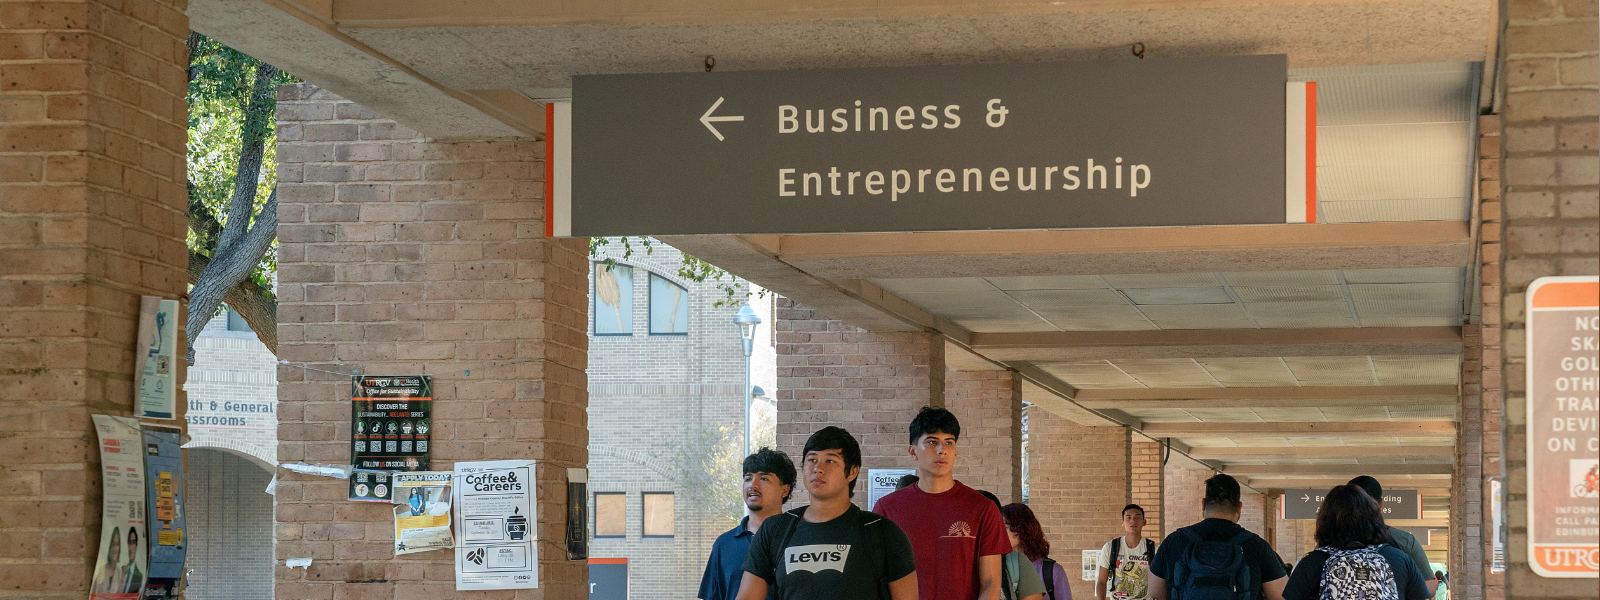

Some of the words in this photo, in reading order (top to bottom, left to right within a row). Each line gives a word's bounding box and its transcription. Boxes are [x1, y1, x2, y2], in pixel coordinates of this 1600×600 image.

[778, 100, 961, 134] Business
[985, 98, 1009, 128] &
[778, 156, 1152, 202] Entrepreneurship
[1571, 336, 1599, 351] SK
[1555, 376, 1599, 391] OTH
[366, 388, 378, 396] Office
[379, 388, 387, 396] for
[209, 400, 217, 411] &
[224, 401, 274, 414] General
[1556, 397, 1599, 411] TRA
[1547, 437, 1576, 452] ON
[362, 460, 380, 468] FOLLOW
[474, 482, 522, 492] Careers
[1555, 517, 1580, 525] CALL
[1584, 517, 1599, 525] PA
